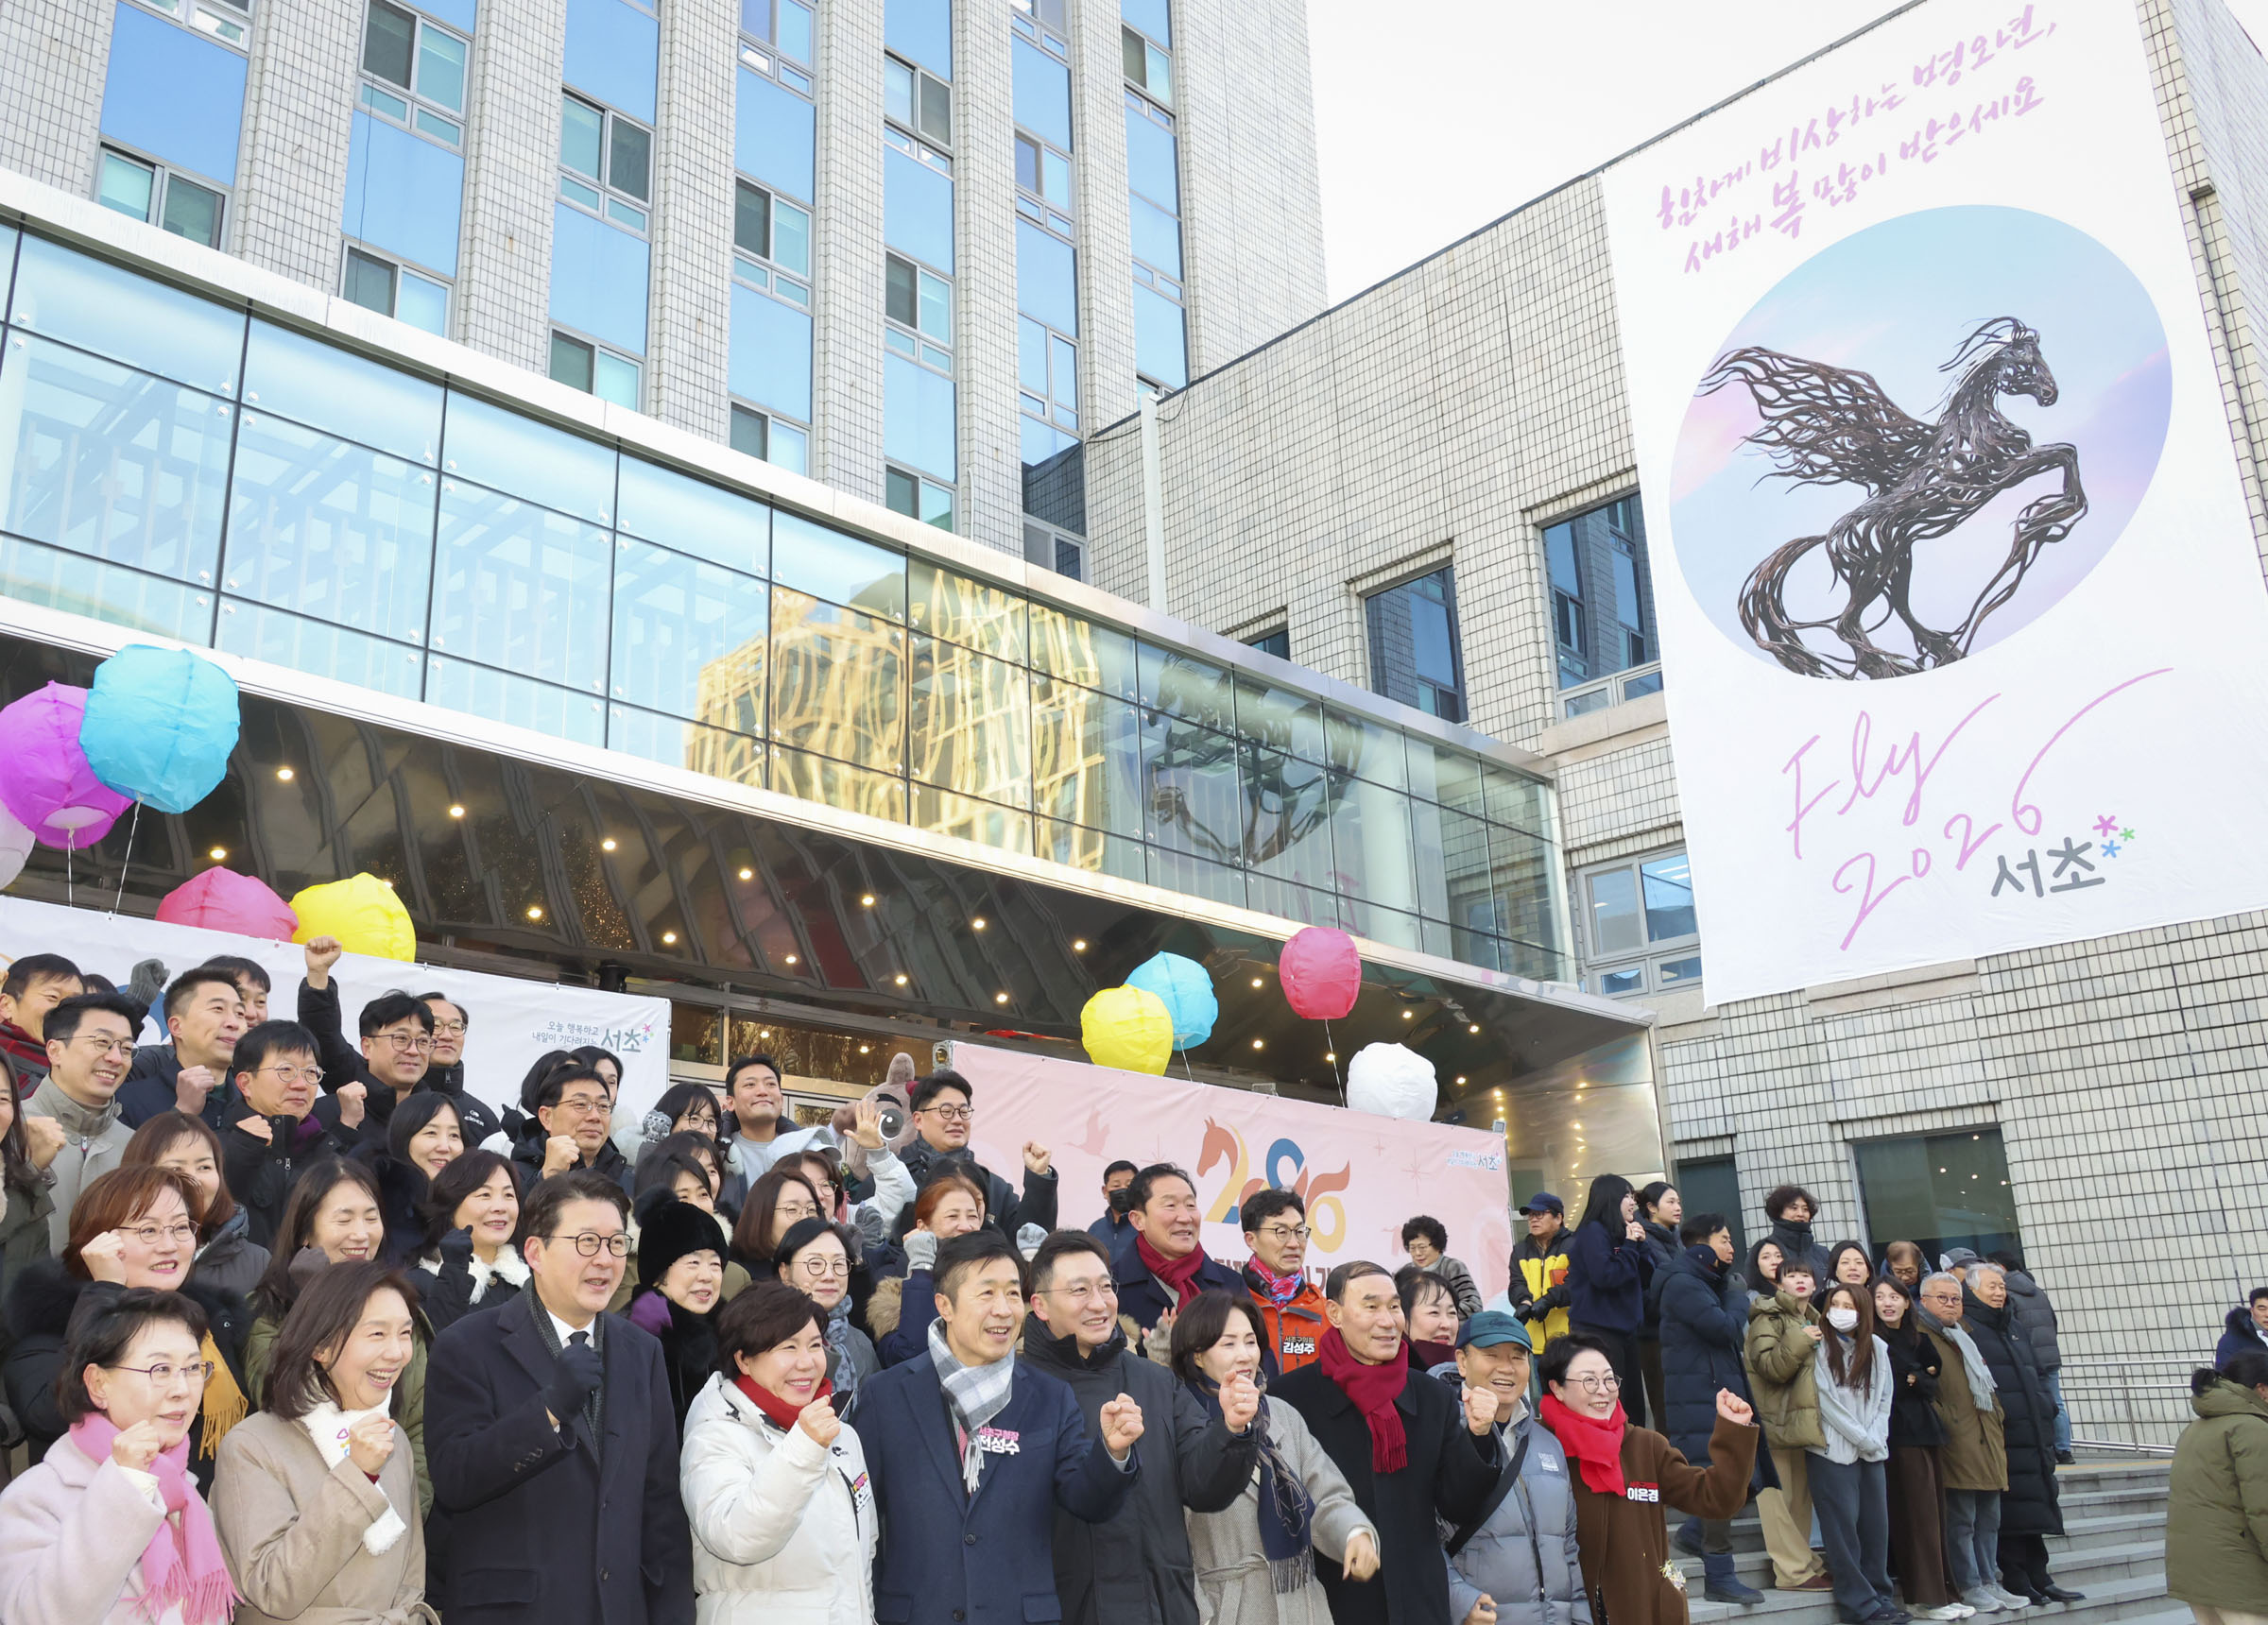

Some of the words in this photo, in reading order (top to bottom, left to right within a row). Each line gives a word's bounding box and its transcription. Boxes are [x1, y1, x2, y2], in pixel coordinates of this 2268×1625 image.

[1657, 161, 1752, 230] 힘차게
[1761, 83, 1907, 171] 비상하는
[1685, 214, 1761, 274] 새해
[1769, 170, 1807, 239] 복
[1813, 152, 1887, 207] 많이
[1899, 75, 2045, 164] 받으세요
[1782, 692, 2002, 861] Fly
[1831, 666, 2174, 951] 2026
[1990, 835, 2107, 899] 서초
[532, 1031, 557, 1044] 내일이
[547, 1020, 564, 1032] 오늘
[567, 1022, 599, 1036] 행복하고
[600, 1027, 642, 1052] 서초
[1282, 1342, 1315, 1355] 김성주
[1626, 1487, 1659, 1502] 이은경
